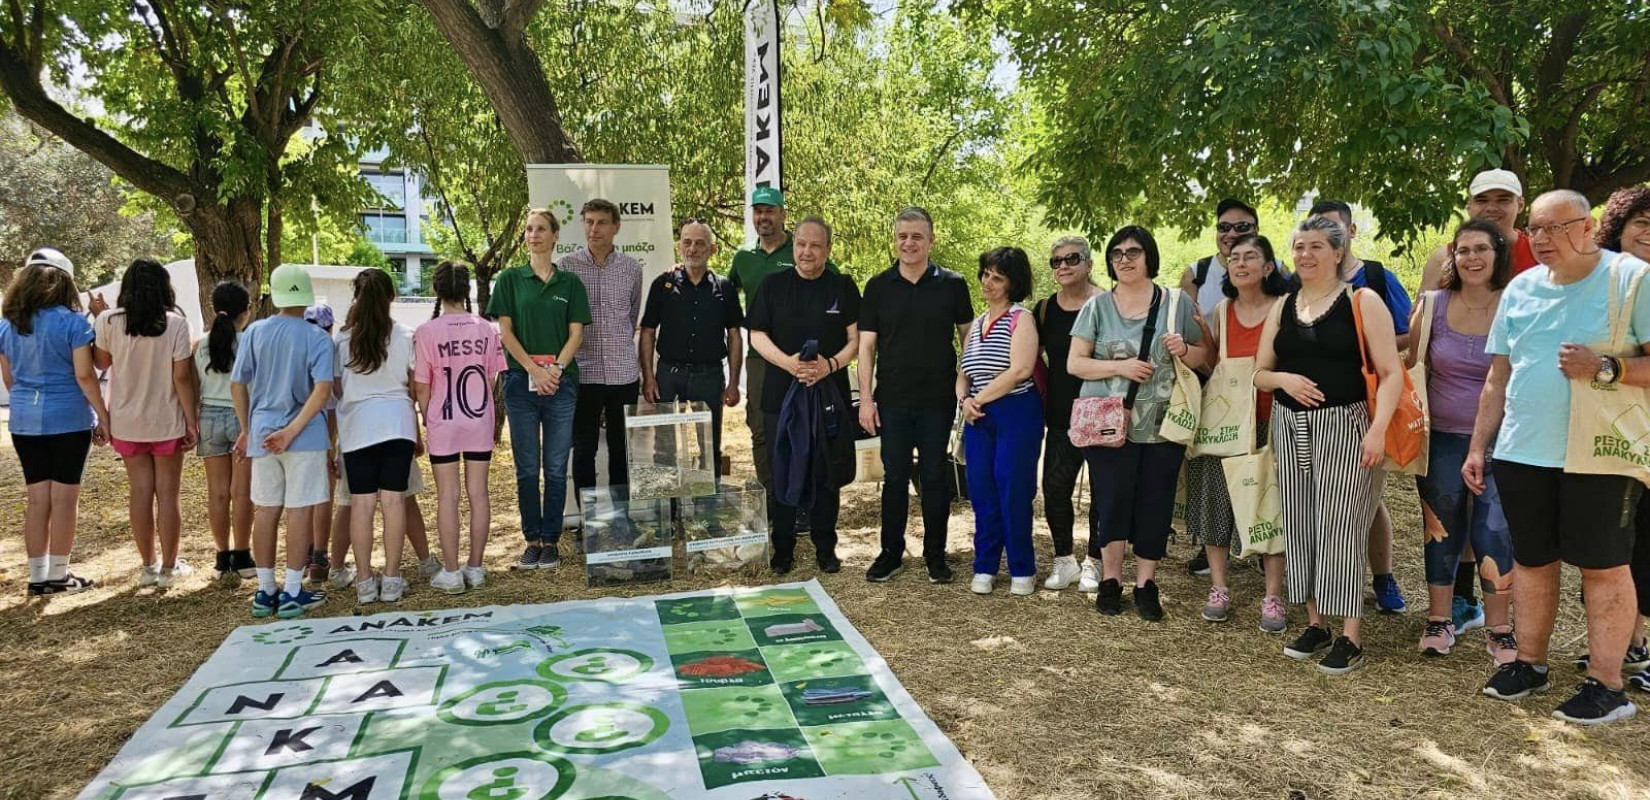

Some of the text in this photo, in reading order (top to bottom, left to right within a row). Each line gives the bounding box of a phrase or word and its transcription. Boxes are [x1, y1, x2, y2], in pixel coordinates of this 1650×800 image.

[438, 337, 489, 358] MESSI
[442, 364, 488, 420] 10
[314, 649, 364, 668] A
[225, 680, 404, 715] N A
[263, 726, 324, 756] K
